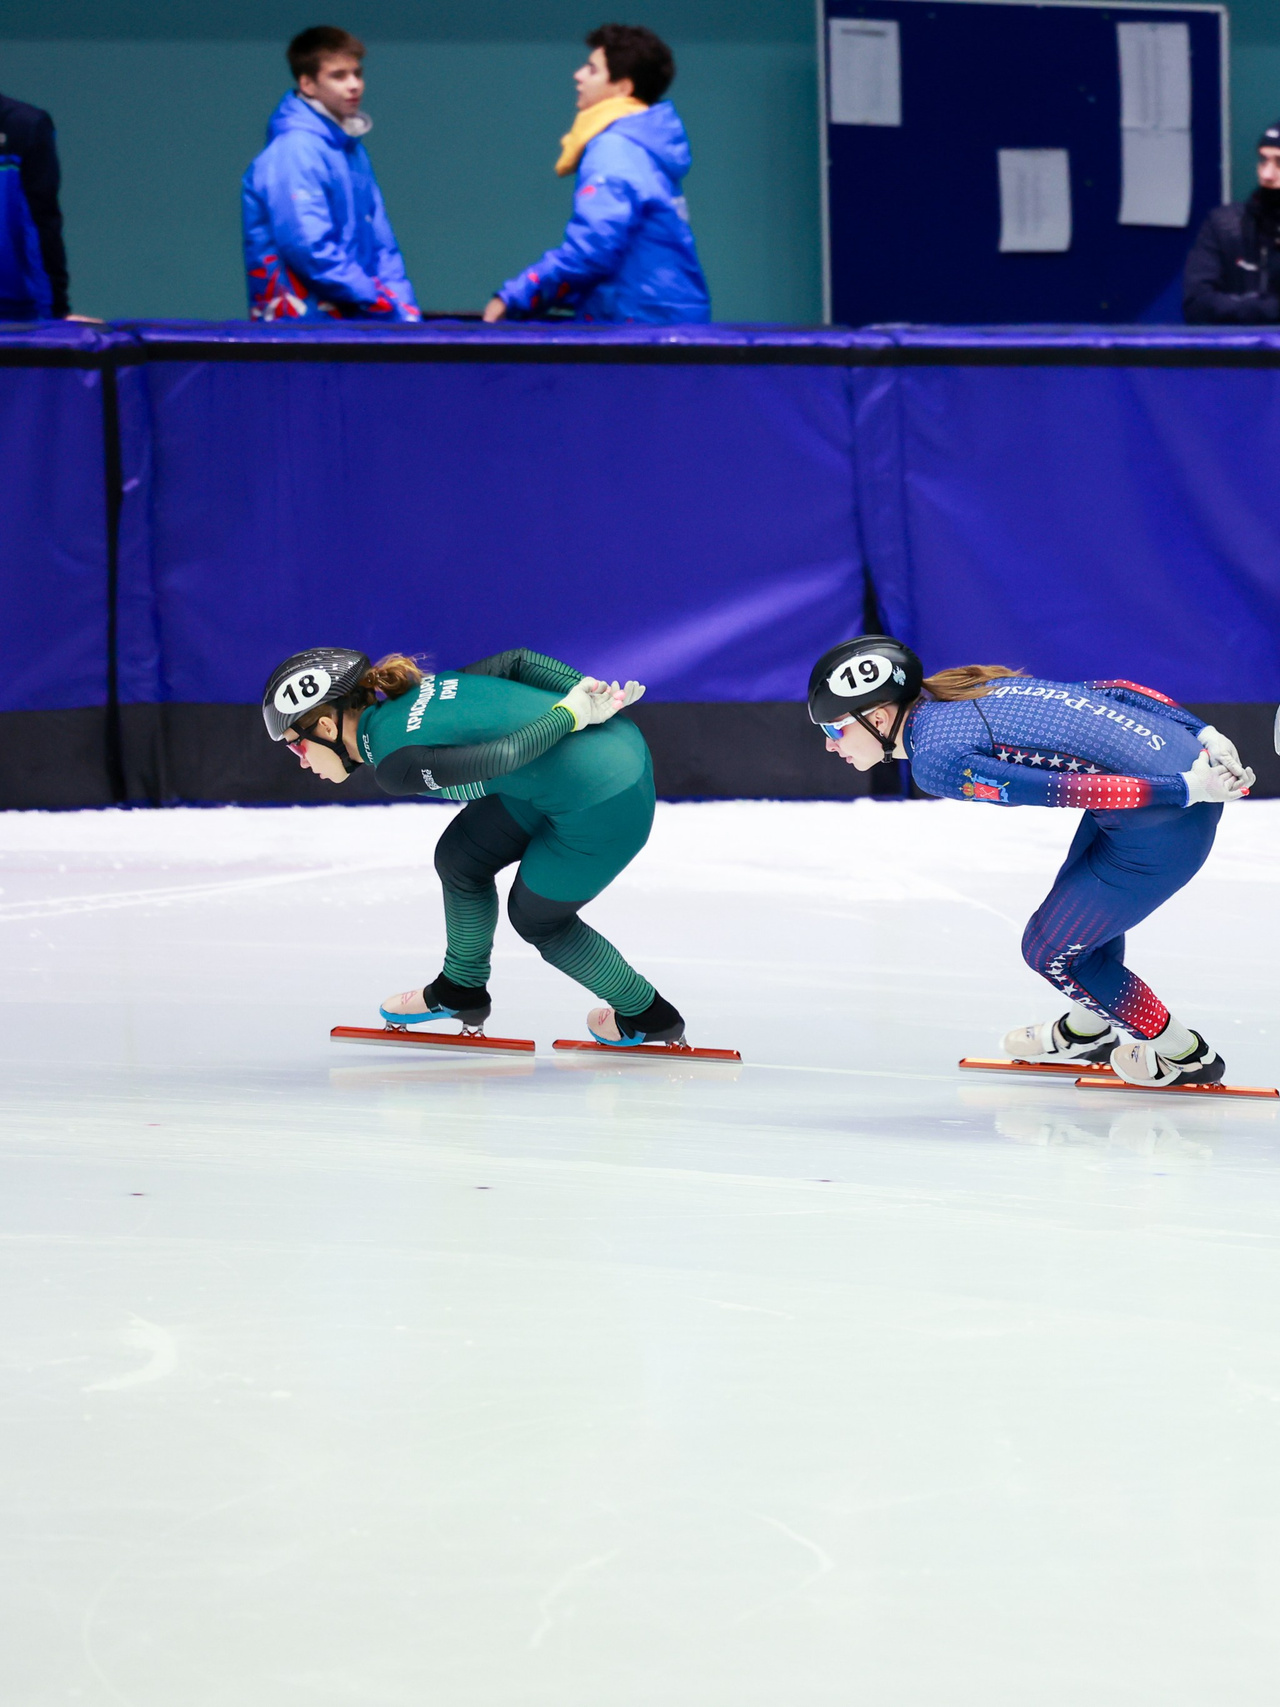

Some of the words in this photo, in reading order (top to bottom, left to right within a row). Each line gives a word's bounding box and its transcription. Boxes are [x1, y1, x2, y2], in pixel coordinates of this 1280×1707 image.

[282, 674, 320, 706] 18
[439, 678, 459, 700] КРАЙ
[840, 659, 880, 690] 19
[988, 685, 1167, 751] Saint-Petersb
